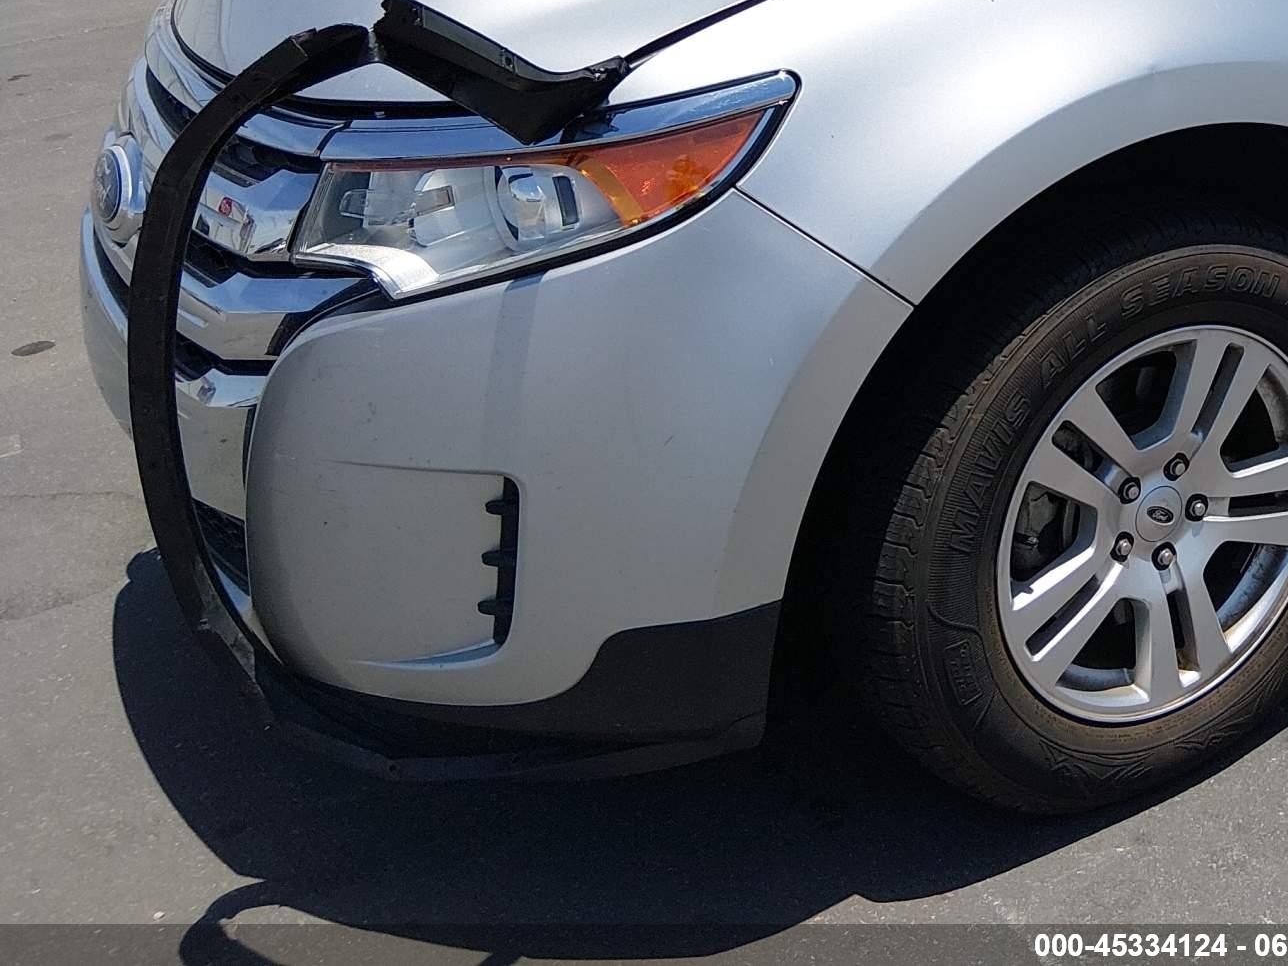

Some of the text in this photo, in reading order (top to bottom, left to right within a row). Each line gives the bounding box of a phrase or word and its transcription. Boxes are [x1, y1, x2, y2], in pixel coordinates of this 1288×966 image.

[950, 390, 1031, 560] MAVIS
[1040, 315, 1108, 387] ALL
[1120, 265, 1281, 319] SEASON
